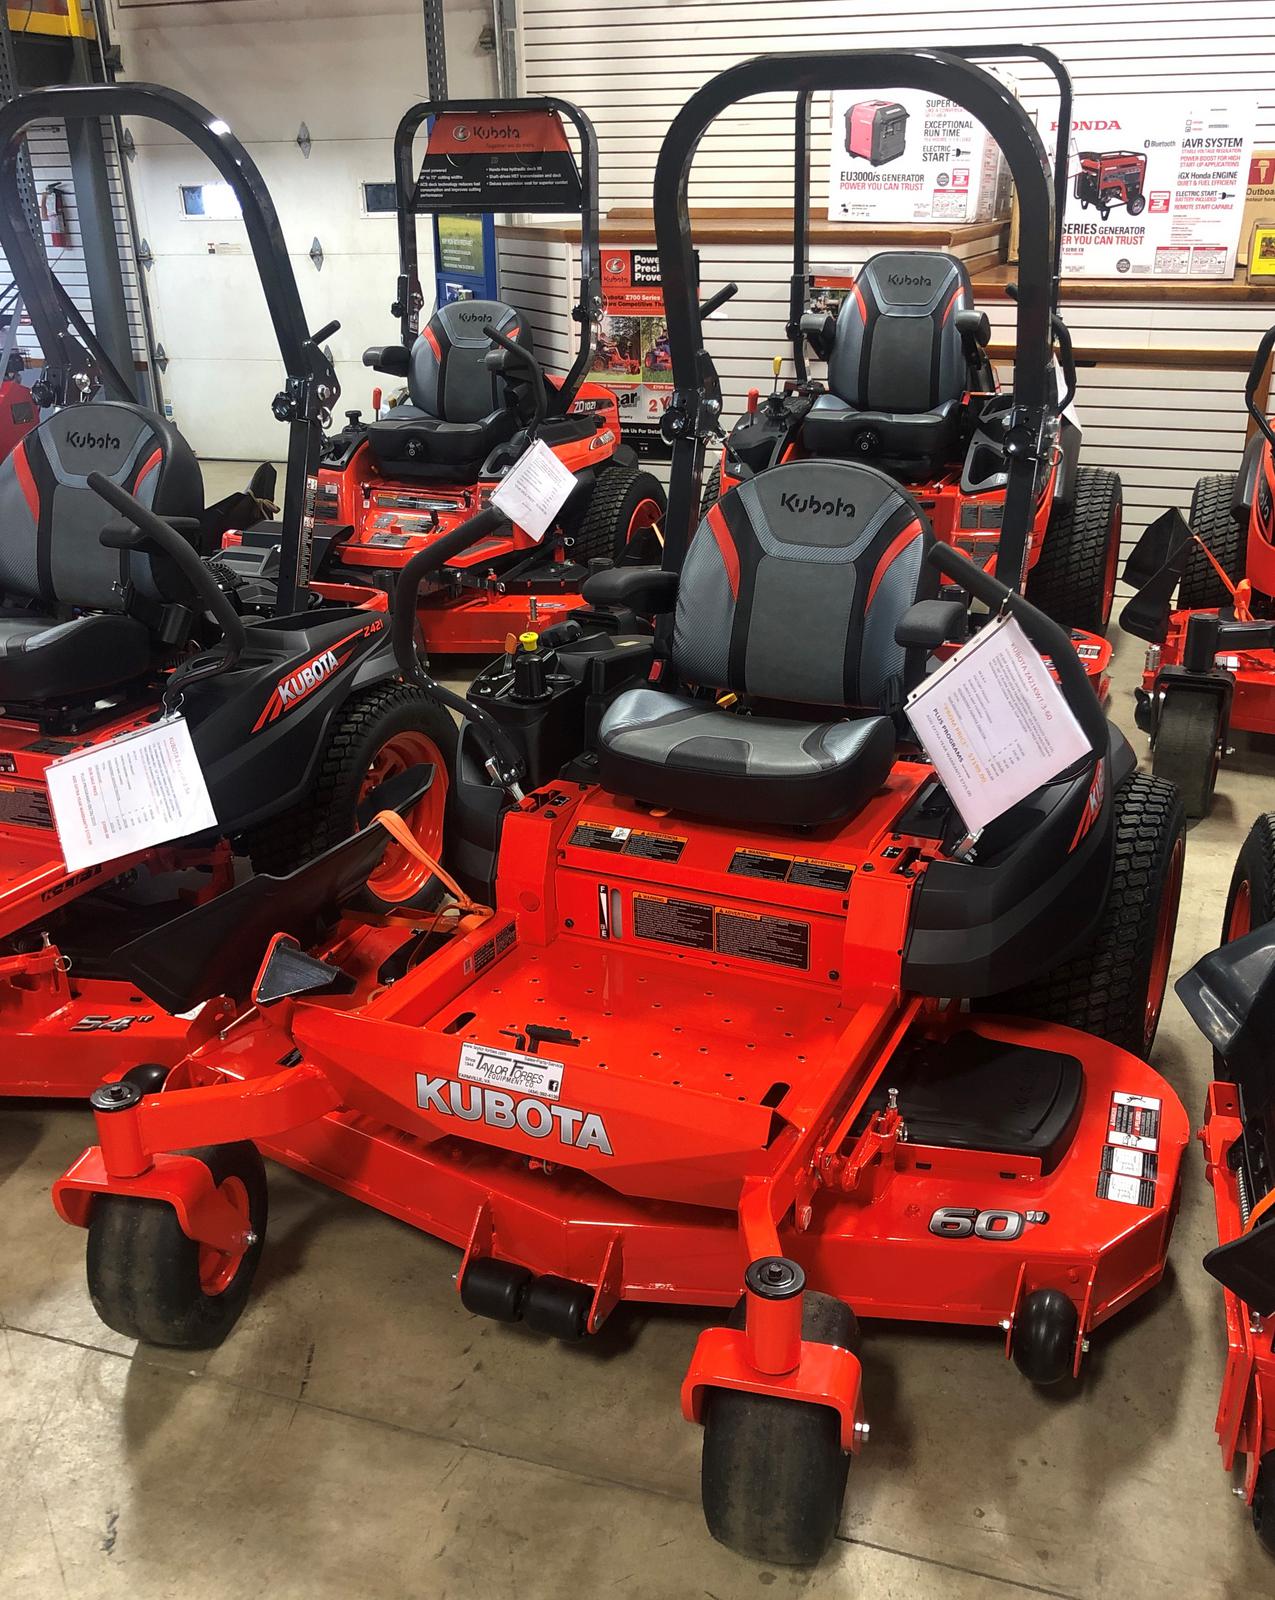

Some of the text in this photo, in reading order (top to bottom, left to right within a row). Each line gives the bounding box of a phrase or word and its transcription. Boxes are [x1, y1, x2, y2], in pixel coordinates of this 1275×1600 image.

[926, 100, 950, 108] SUPER
[925, 120, 974, 129] EXCEPTIONAL
[473, 125, 520, 139] Kubota
[924, 129, 961, 137] RUN TIME
[1151, 139, 1176, 148] Bluetooth
[1181, 138, 1243, 148] iAVR SYSTEM
[922, 152, 951, 162] START
[840, 171, 925, 182] EU3000is GENERATOR
[1178, 171, 1238, 180] iGX Honda ENGINE
[840, 183, 924, 191] POWER YOU CAN TRUST
[1246, 187, 1275, 196] Outboa
[1062, 223, 1146, 235] SERIES GENERATOR
[1073, 235, 1092, 245] YOU
[1094, 235, 1114, 246] CAN
[1115, 235, 1145, 246] TRUST
[634, 254, 660, 264] Powe
[634, 263, 660, 273] Preci
[634, 272, 662, 282] Prove
[888, 273, 932, 287] Kubota
[458, 312, 493, 323] Kubota
[648, 399, 658, 413] 2
[66, 431, 121, 450] Kubota
[780, 492, 856, 518] Kubota
[363, 618, 384, 638] Z421
[277, 650, 340, 705] KUBOTA
[932, 708, 964, 764] PLUS PROGRAMS
[748, 848, 771, 857] WARNING
[600, 885, 606, 893] F
[510, 1059, 548, 1085] FORBES
[488, 1072, 535, 1088] EQUIPMENT CO.
[415, 1072, 615, 1156] KUBOTA
